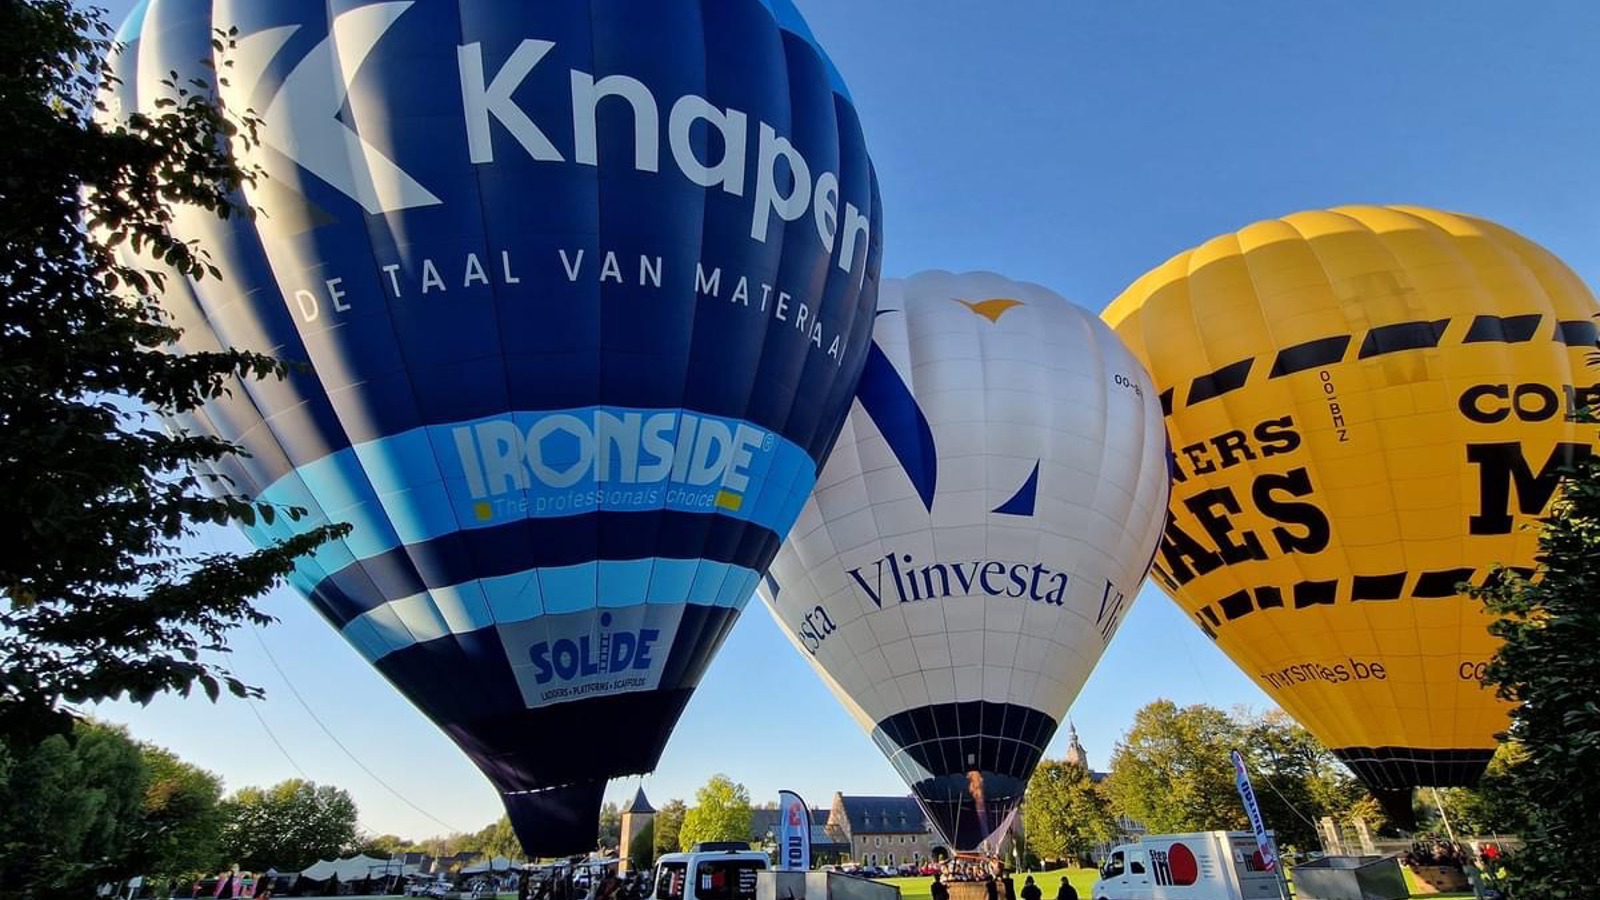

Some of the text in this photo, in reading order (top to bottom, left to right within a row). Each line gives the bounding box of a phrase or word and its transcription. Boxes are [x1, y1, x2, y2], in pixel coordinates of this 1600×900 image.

[457, 38, 870, 290] Knapen
[295, 277, 351, 323] DE
[382, 250, 520, 298] TAAL
[558, 249, 662, 288] VAN
[492, 497, 529, 514] The
[1153, 467, 1331, 591] AES
[845, 552, 1069, 611] Vlinvesta
